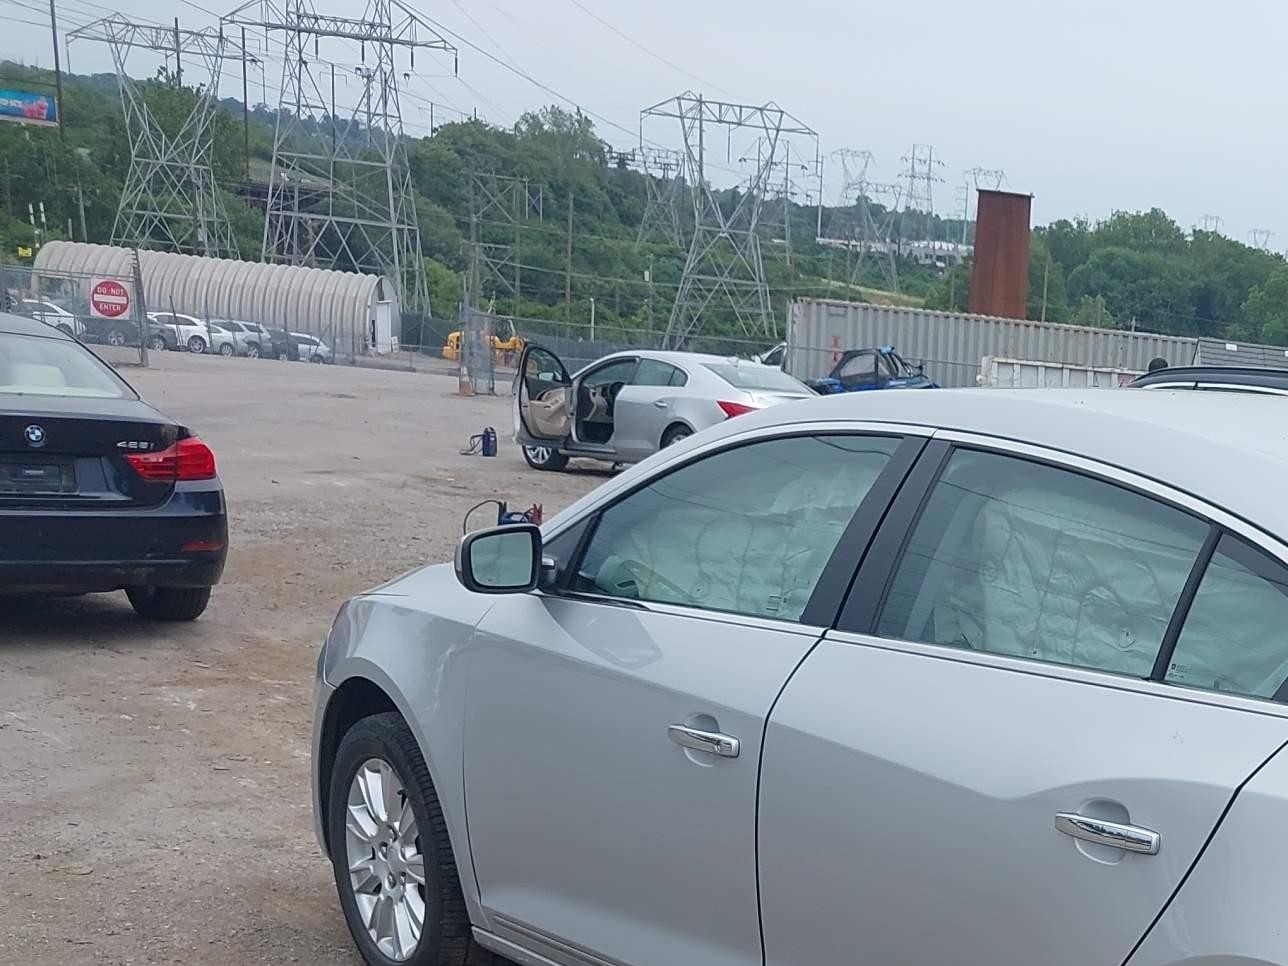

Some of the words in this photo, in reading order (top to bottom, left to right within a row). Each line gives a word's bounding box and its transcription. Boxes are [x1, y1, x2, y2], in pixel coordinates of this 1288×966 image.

[97, 286, 107, 294] DO
[110, 287, 124, 296] NOT
[99, 303, 121, 311] ENTER
